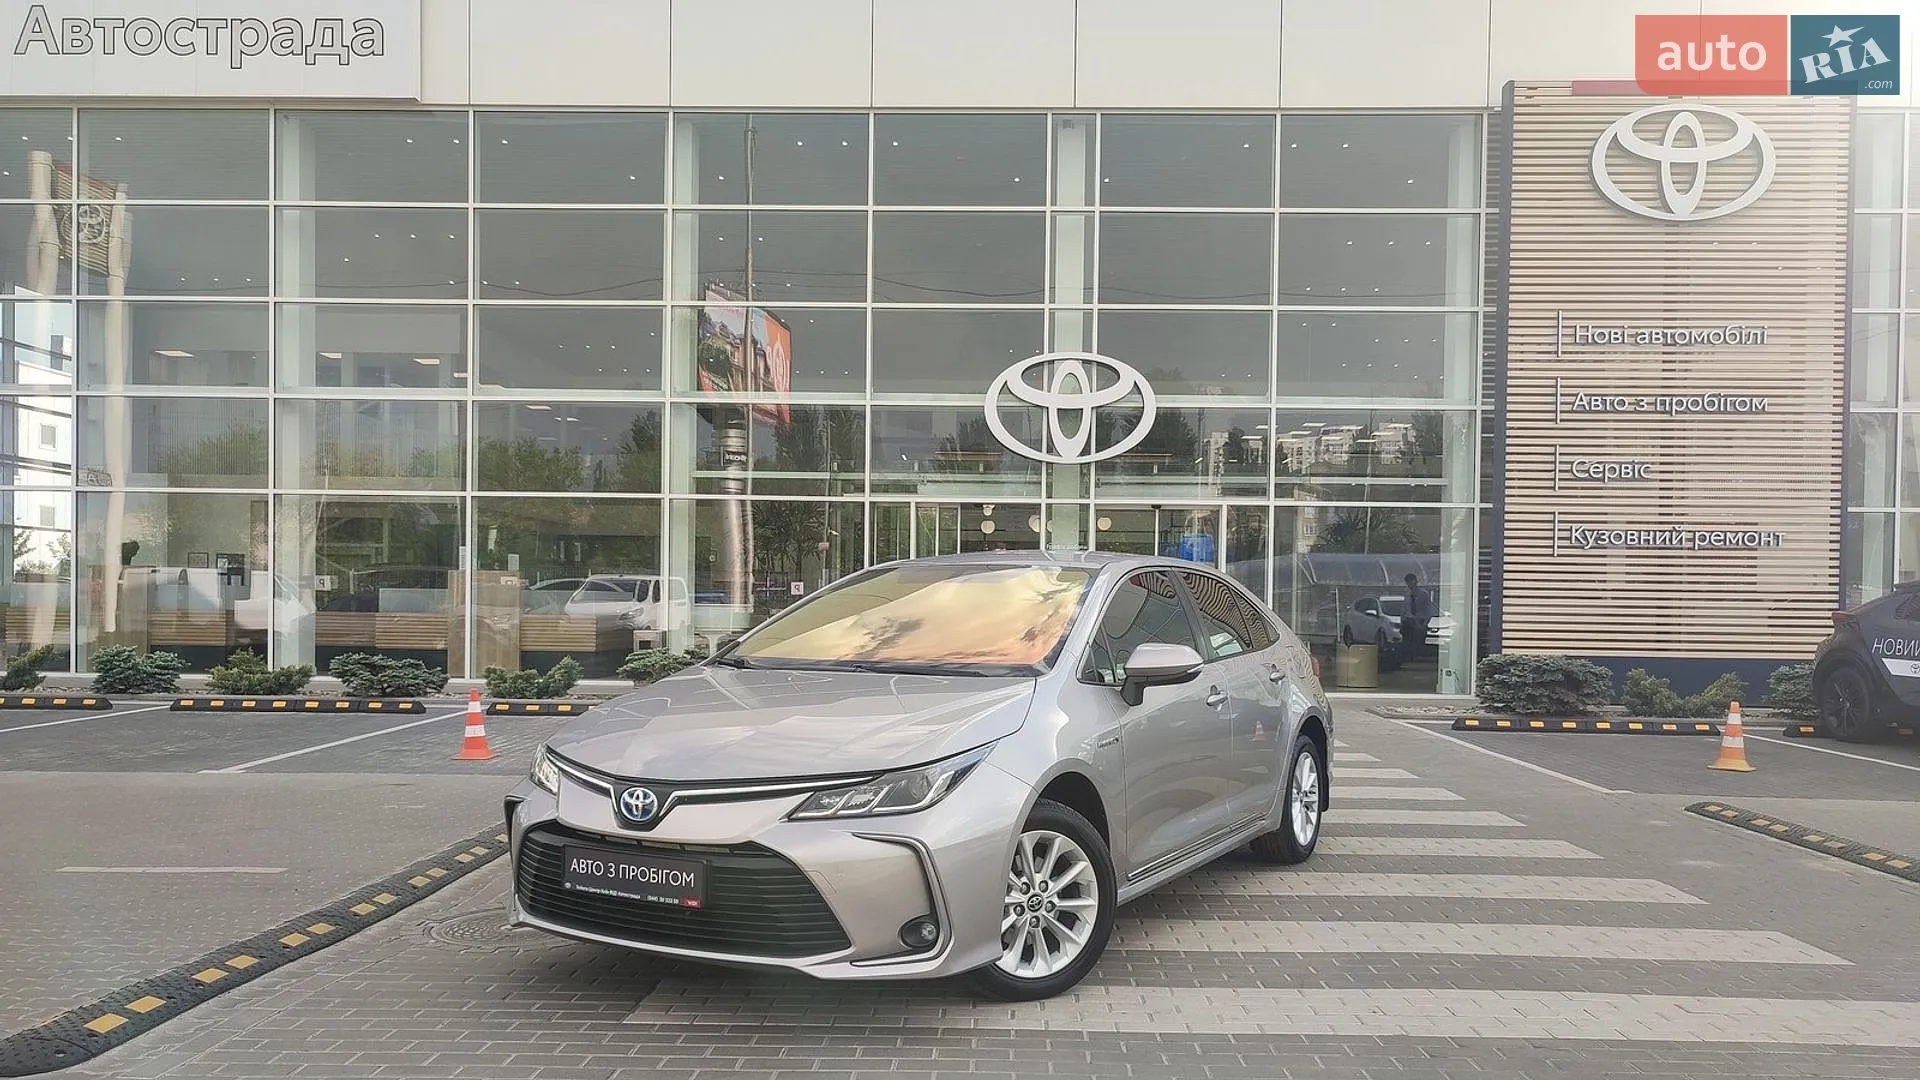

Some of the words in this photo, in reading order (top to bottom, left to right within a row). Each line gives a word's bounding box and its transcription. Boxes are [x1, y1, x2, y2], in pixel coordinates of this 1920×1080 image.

[13, 4, 385, 70] Автострада
[1574, 324, 1629, 345] Нові
[1635, 325, 1768, 345] автомобілі
[1572, 391, 1629, 412] Авто
[1635, 396, 1648, 412] з
[1655, 391, 1769, 416] пробігом
[1571, 459, 1652, 483] Сервіс
[1570, 524, 1686, 550] Кузовний
[1694, 530, 1787, 550] ремонт
[570, 858, 604, 876] АВТО
[607, 862, 616, 878] З
[619, 864, 695, 888] ПРОБІГОМ
